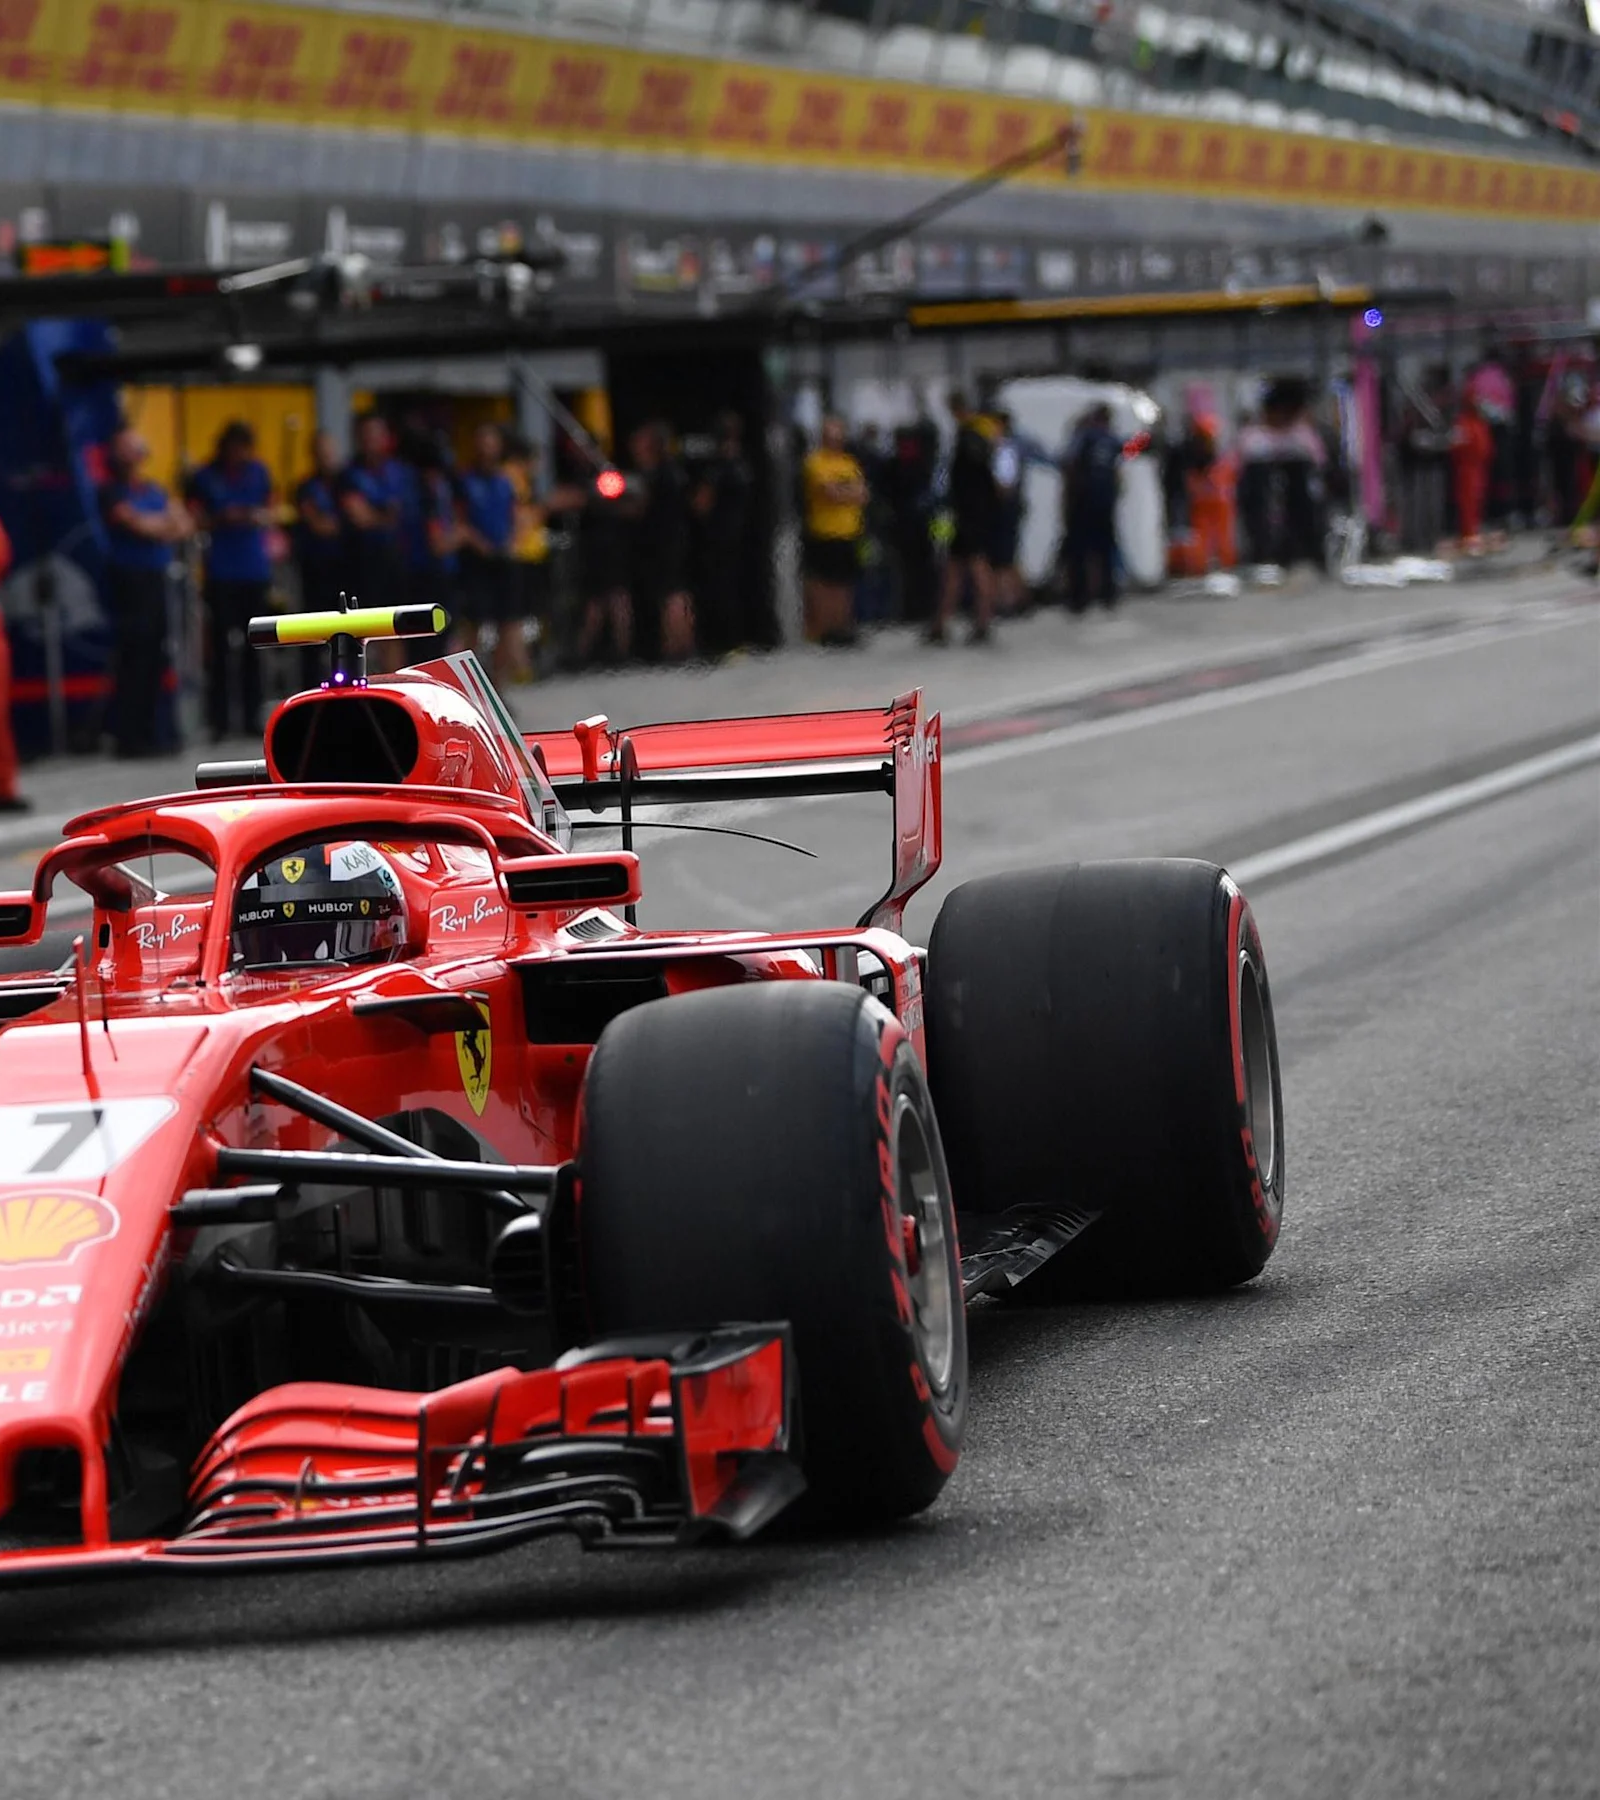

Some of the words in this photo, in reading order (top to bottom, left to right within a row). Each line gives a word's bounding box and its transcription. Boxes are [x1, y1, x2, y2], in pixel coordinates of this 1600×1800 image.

[238, 908, 276, 924] HUBLOT
[308, 902, 354, 915] HUBLOT
[430, 896, 504, 932] Ray-Ban
[127, 914, 201, 949] Ray-Ban
[26, 1109, 104, 1174] 7
